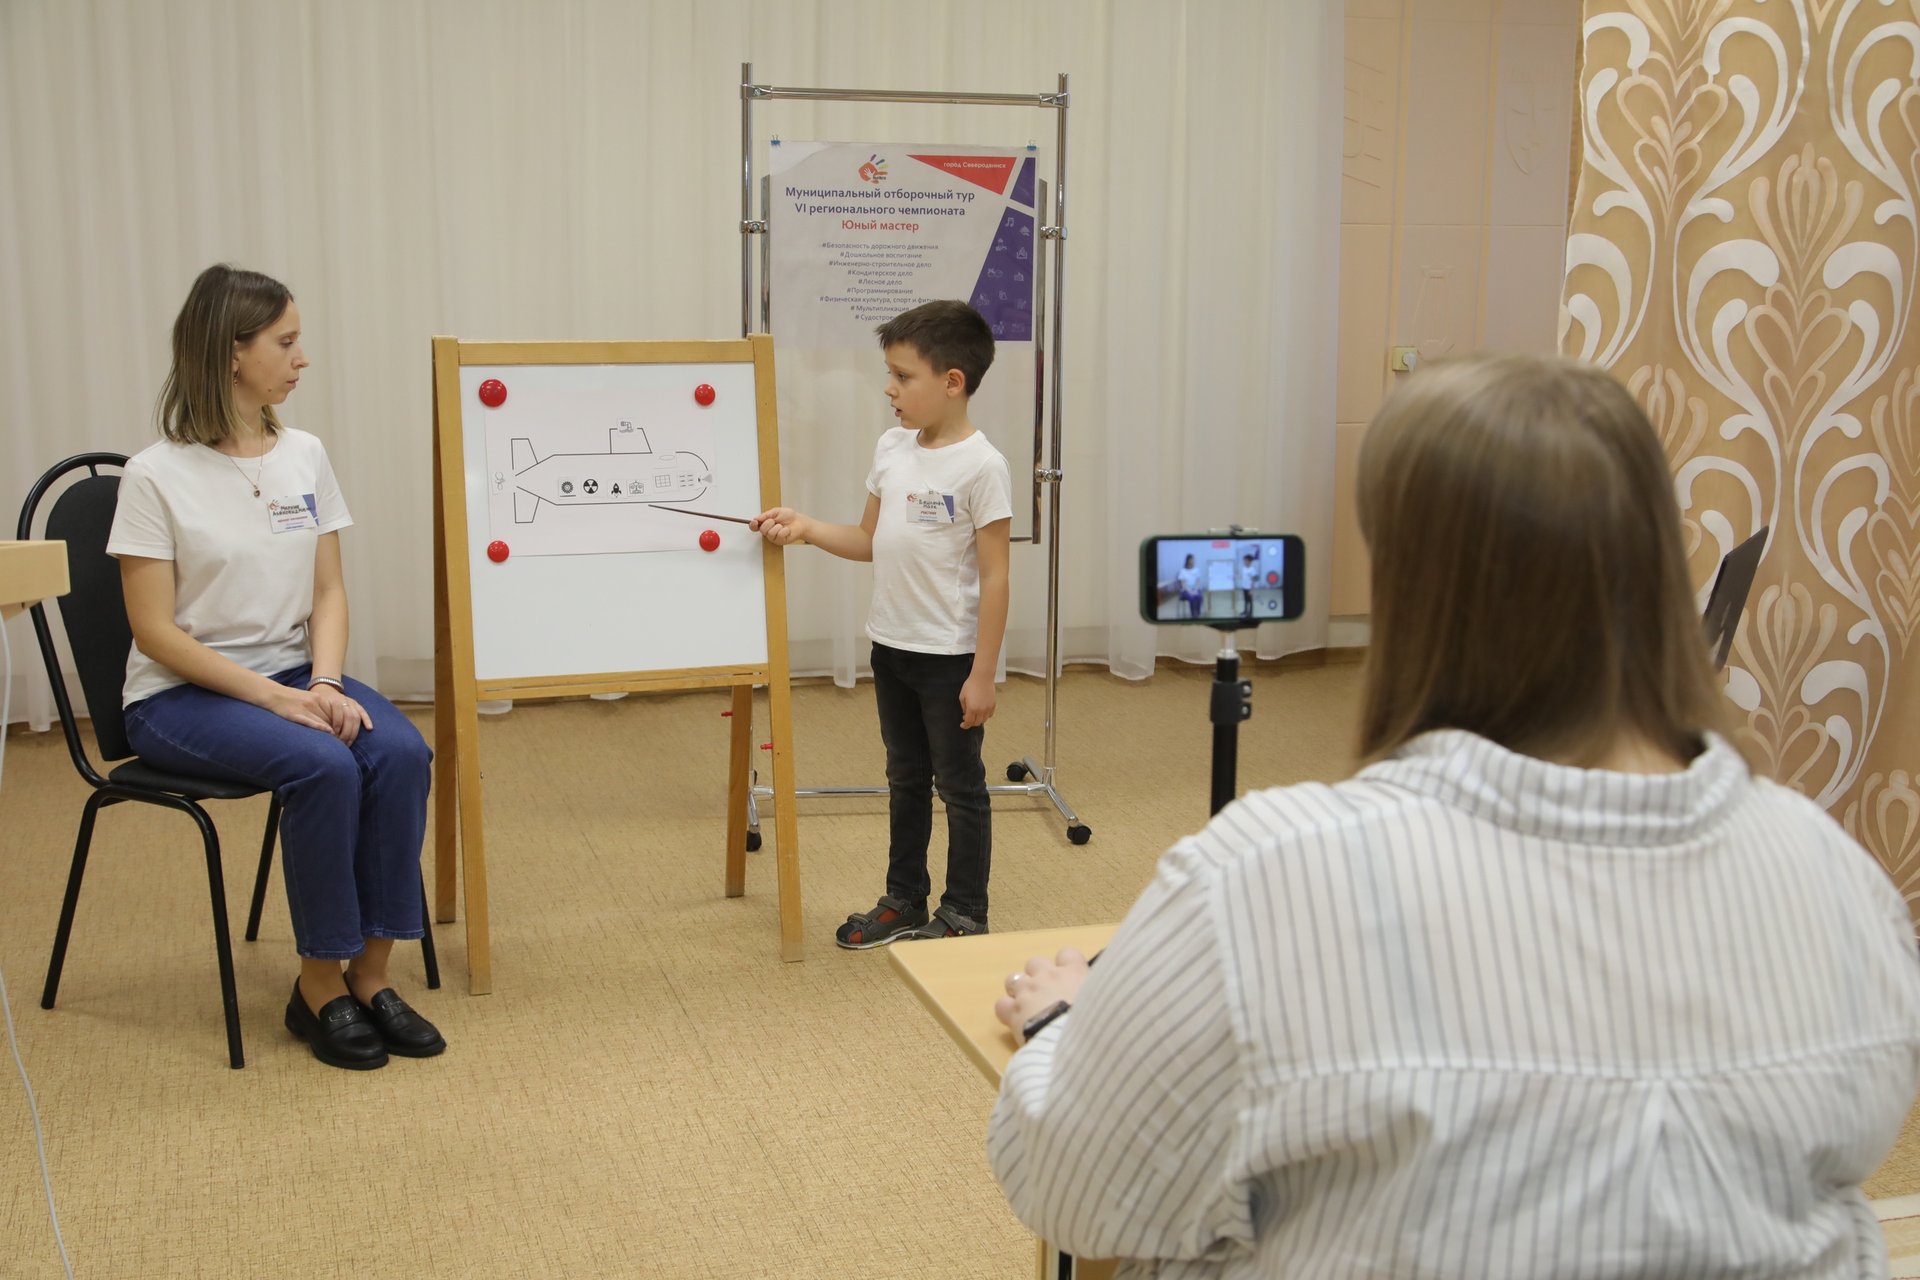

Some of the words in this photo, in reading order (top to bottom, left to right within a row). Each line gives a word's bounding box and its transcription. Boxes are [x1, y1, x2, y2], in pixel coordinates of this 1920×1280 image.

[786, 187, 881, 199] Муниципальный
[884, 188, 953, 199] отборочный
[956, 192, 975, 201] тур
[795, 204, 806, 213] VI
[810, 205, 895, 216] регионального
[898, 207, 965, 217] чемпионата
[842, 219, 877, 230] Юный
[880, 222, 919, 233] мастер
